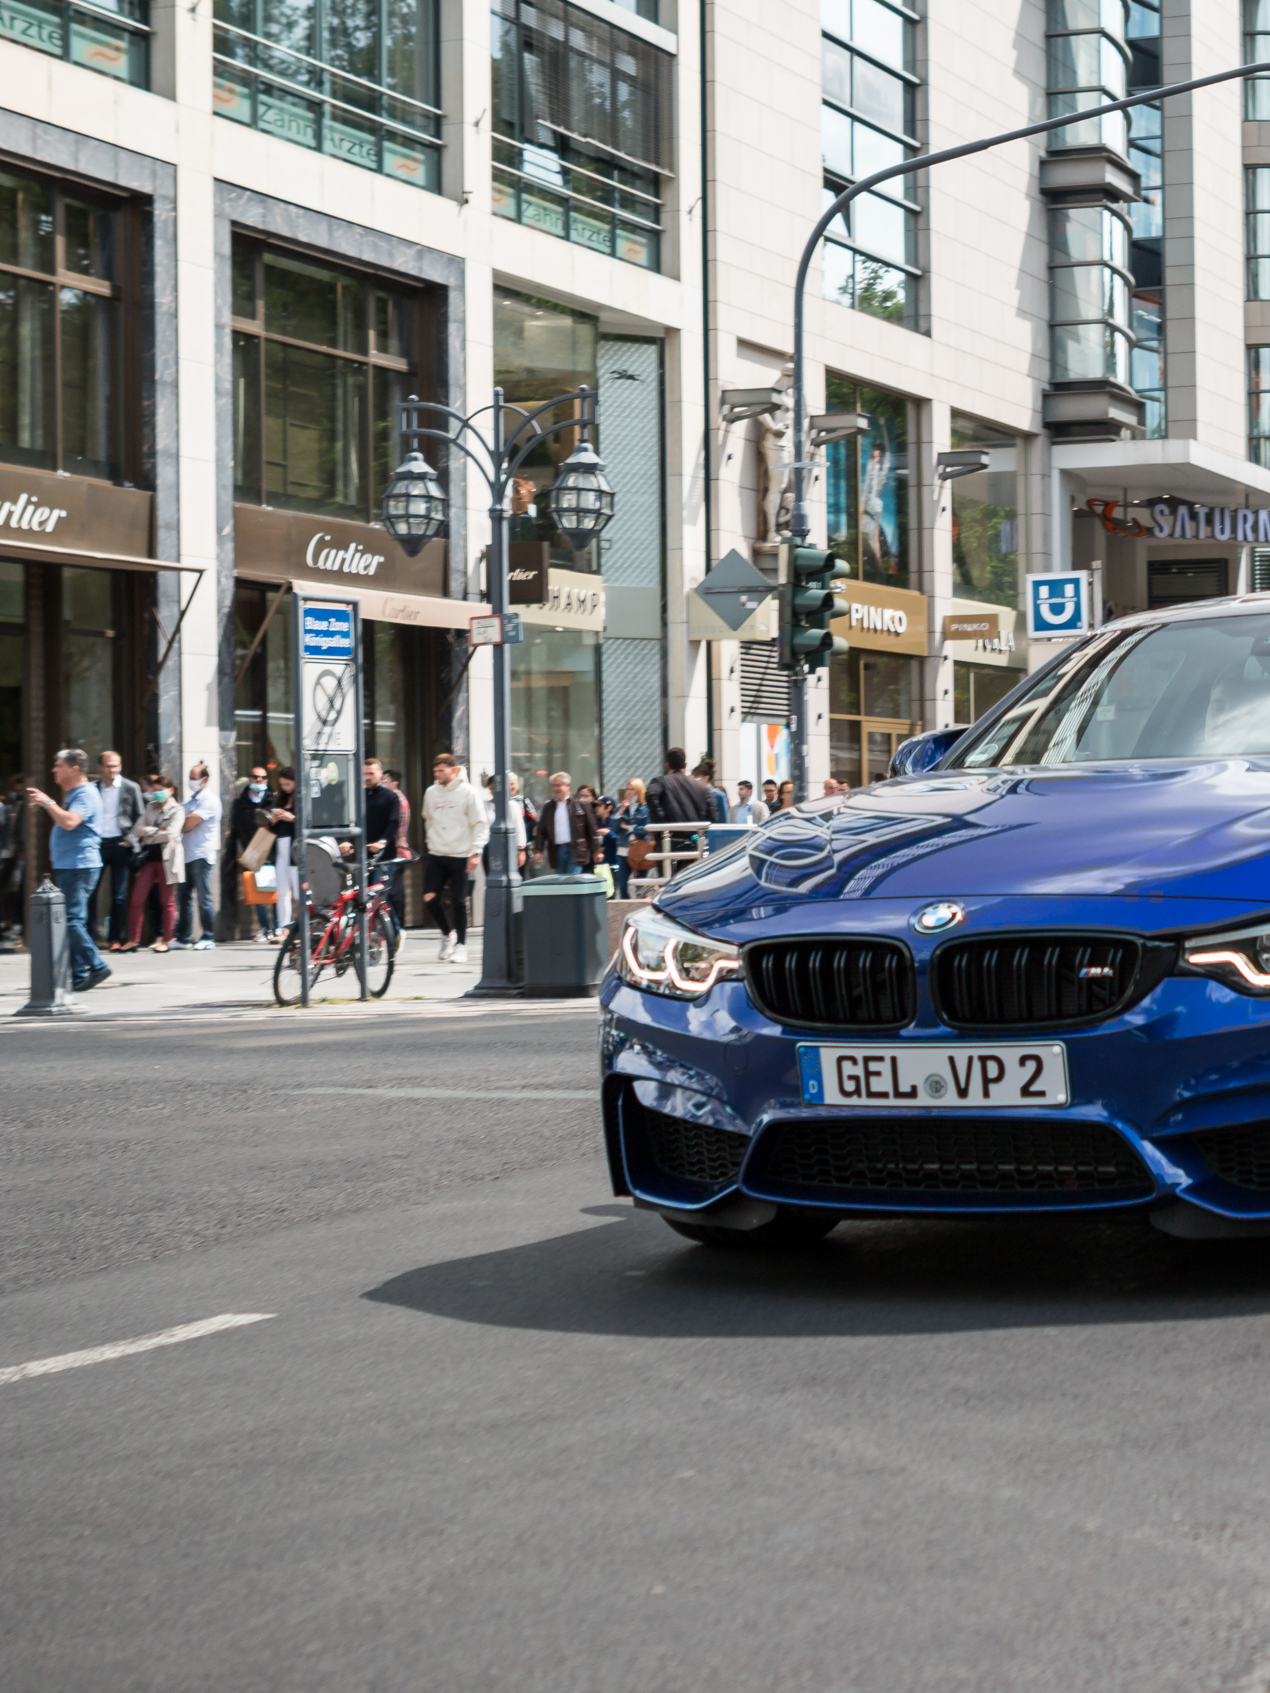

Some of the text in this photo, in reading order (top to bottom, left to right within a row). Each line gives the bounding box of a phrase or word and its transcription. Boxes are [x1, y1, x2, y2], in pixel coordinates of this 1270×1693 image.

[0, 492, 67, 532] rtier
[306, 532, 384, 575] Cartier
[506, 568, 538, 580] rtier
[547, 585, 600, 616] HAMP
[851, 602, 907, 634] PINKO
[950, 623, 989, 632] PINKO
[836, 1054, 1047, 1099] GEL VP 2
